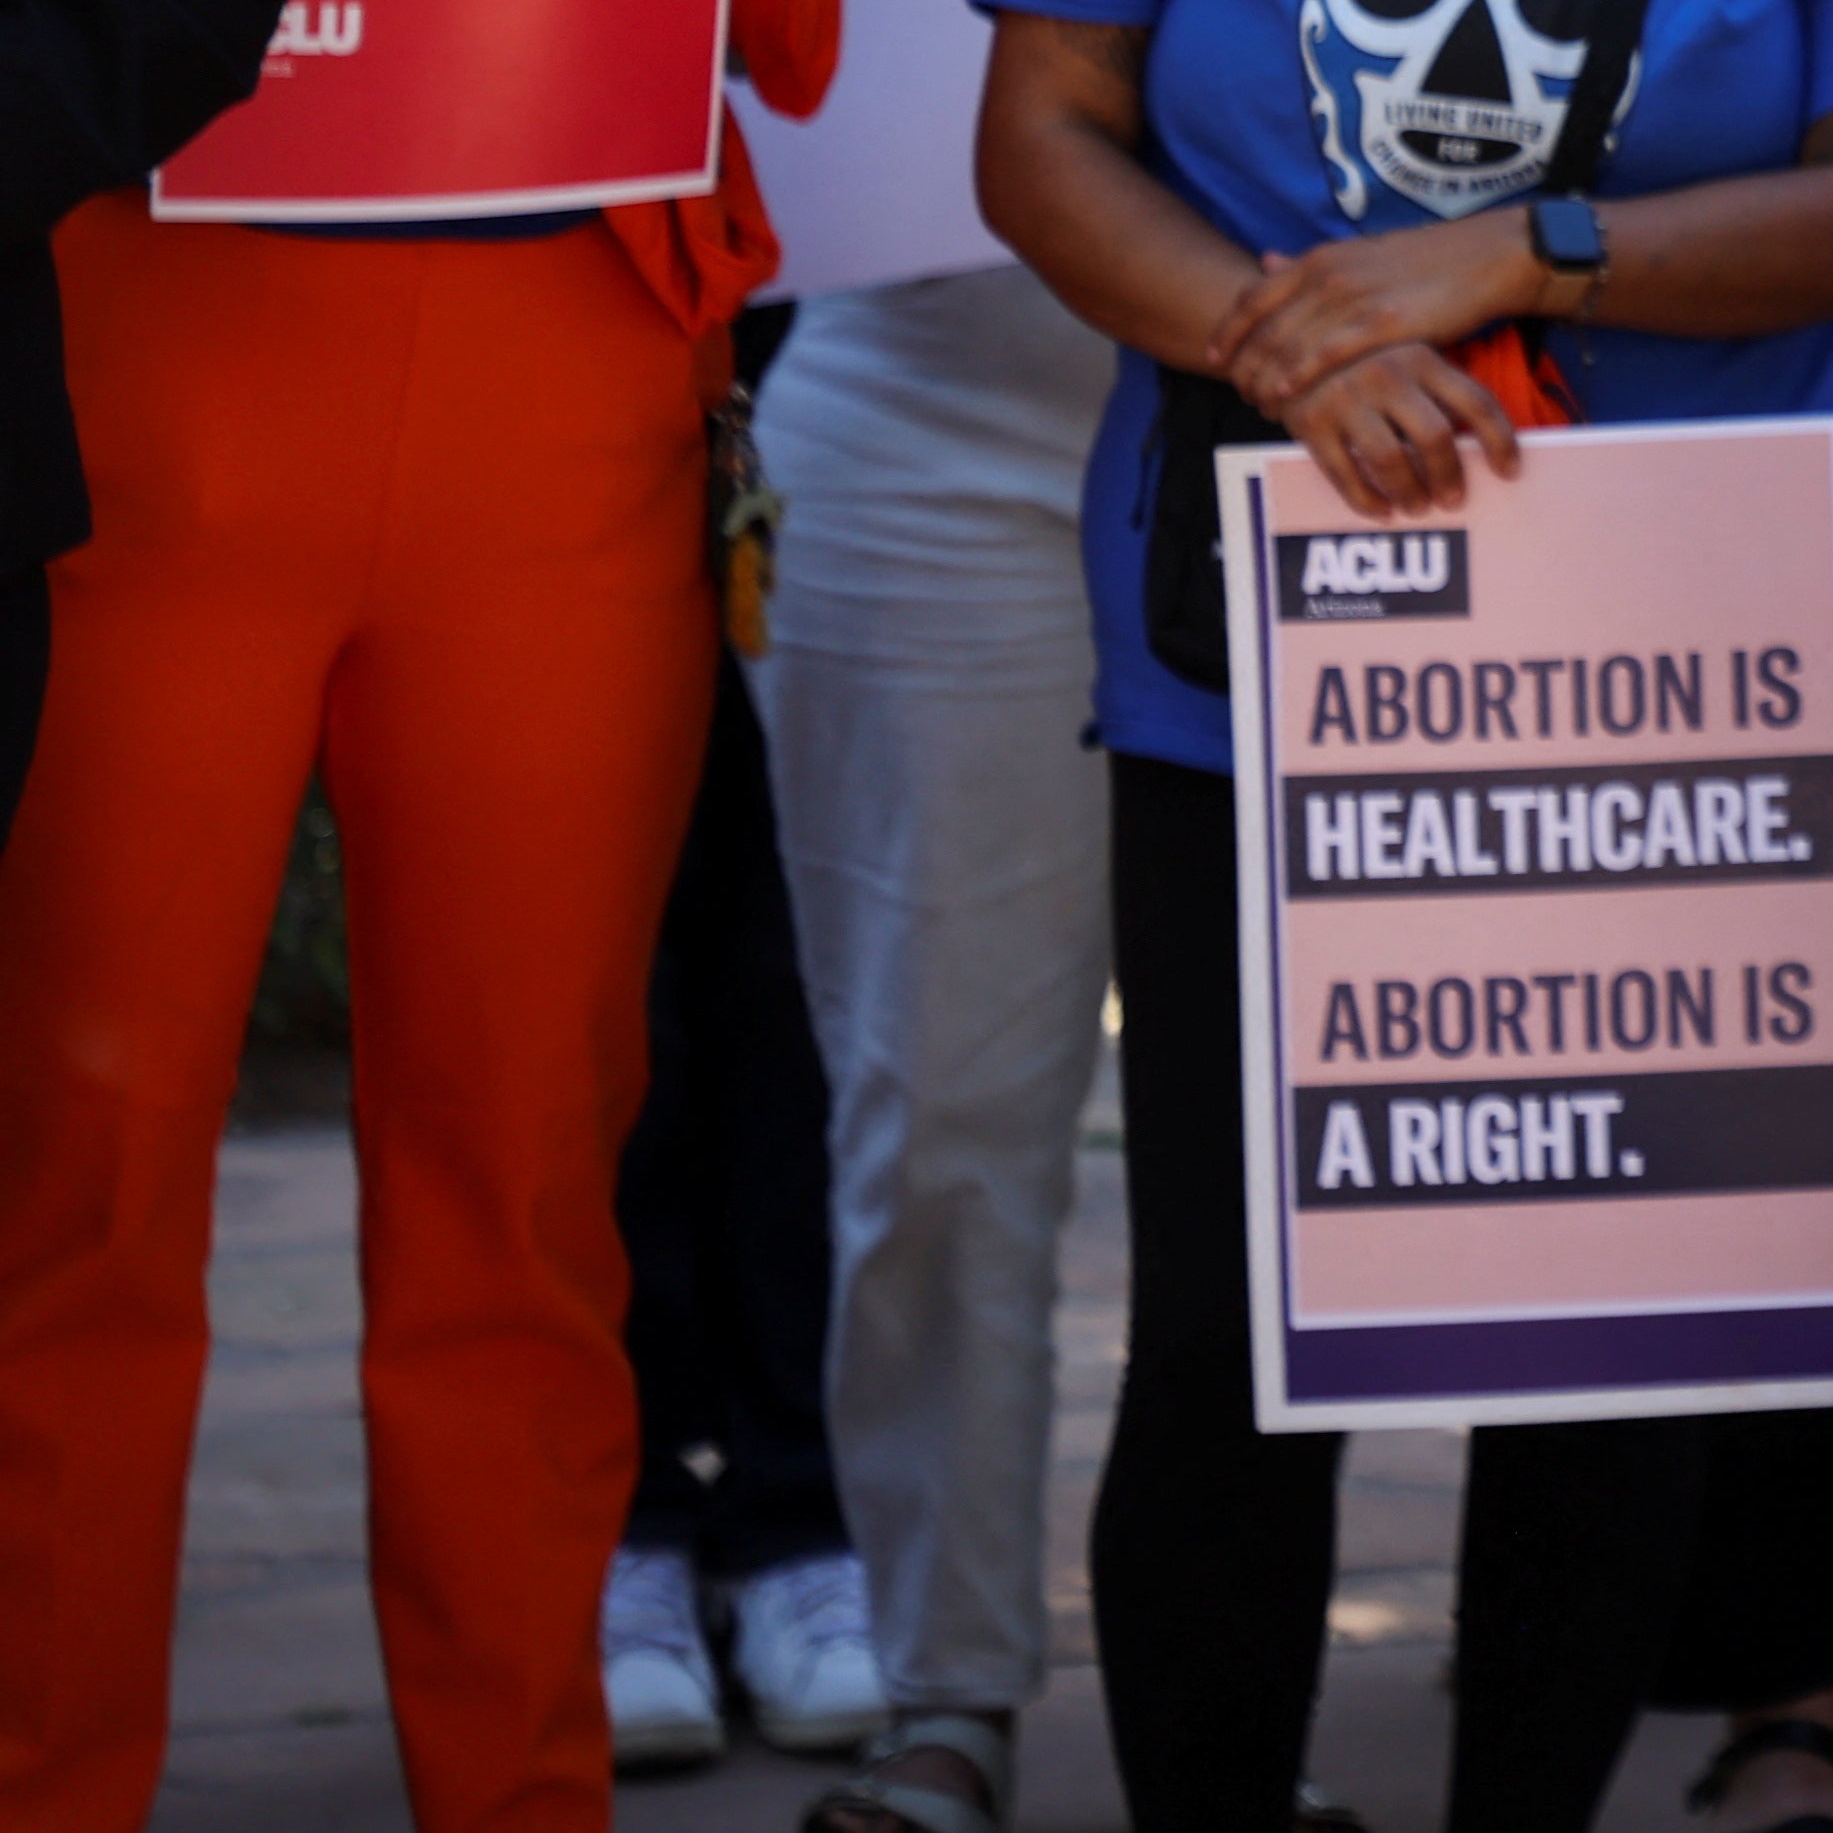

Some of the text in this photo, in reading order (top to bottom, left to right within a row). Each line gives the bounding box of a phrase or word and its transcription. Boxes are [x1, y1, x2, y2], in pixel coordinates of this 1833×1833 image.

[1303, 534, 1450, 596] ACLU
[1309, 646, 1804, 748] ABORTION IS
[1306, 774, 1812, 882] HEALTHCARE.
[1320, 960, 1815, 1064] ABORTION IS
[1317, 1091, 1645, 1190] A RIGHT.
